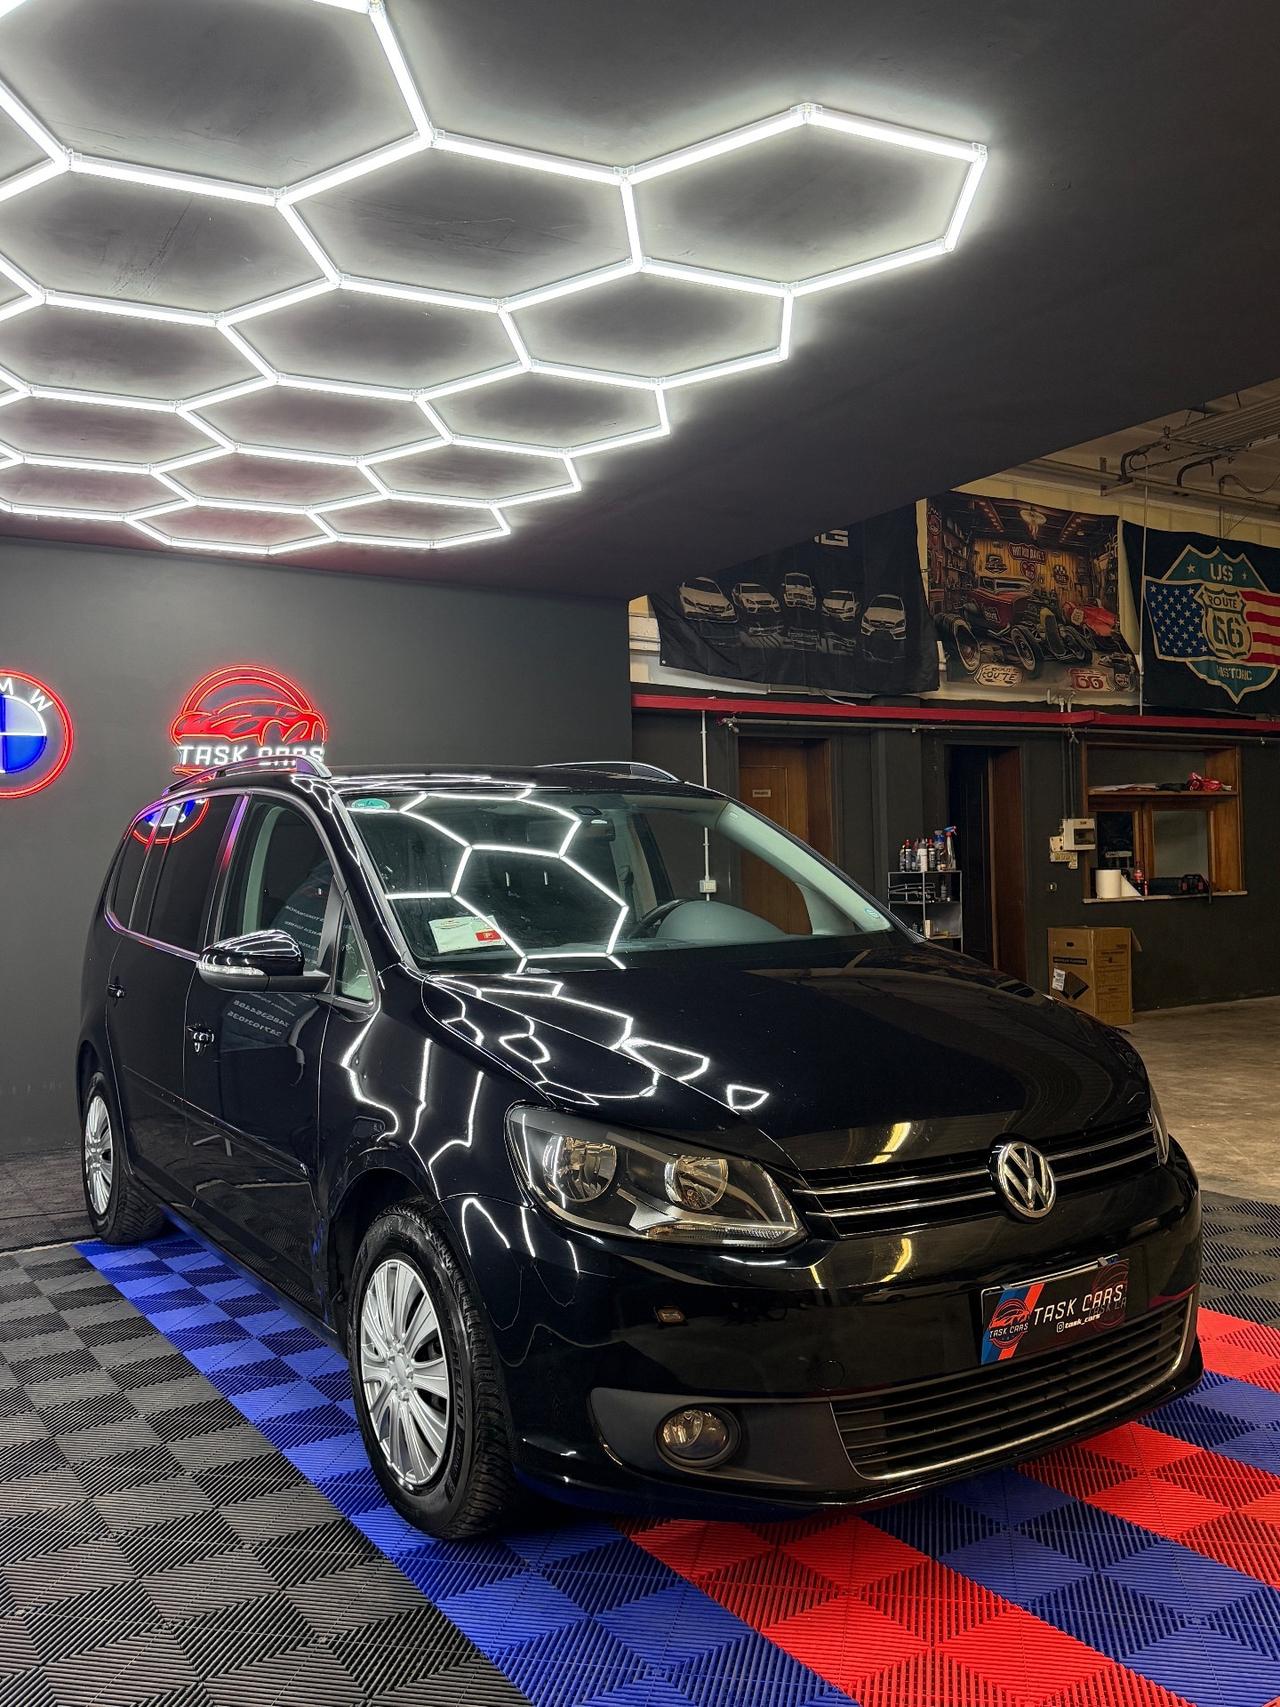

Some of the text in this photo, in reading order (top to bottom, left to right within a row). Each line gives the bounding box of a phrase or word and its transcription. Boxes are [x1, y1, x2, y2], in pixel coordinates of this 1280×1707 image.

[1210, 563, 1233, 581] US
[1208, 594, 1237, 609] ROUTE
[1213, 614, 1244, 649] 66
[178, 745, 248, 766] TASK
[1034, 1284, 1124, 1326] TASK CARS
[990, 1328, 1008, 1338] TASK
